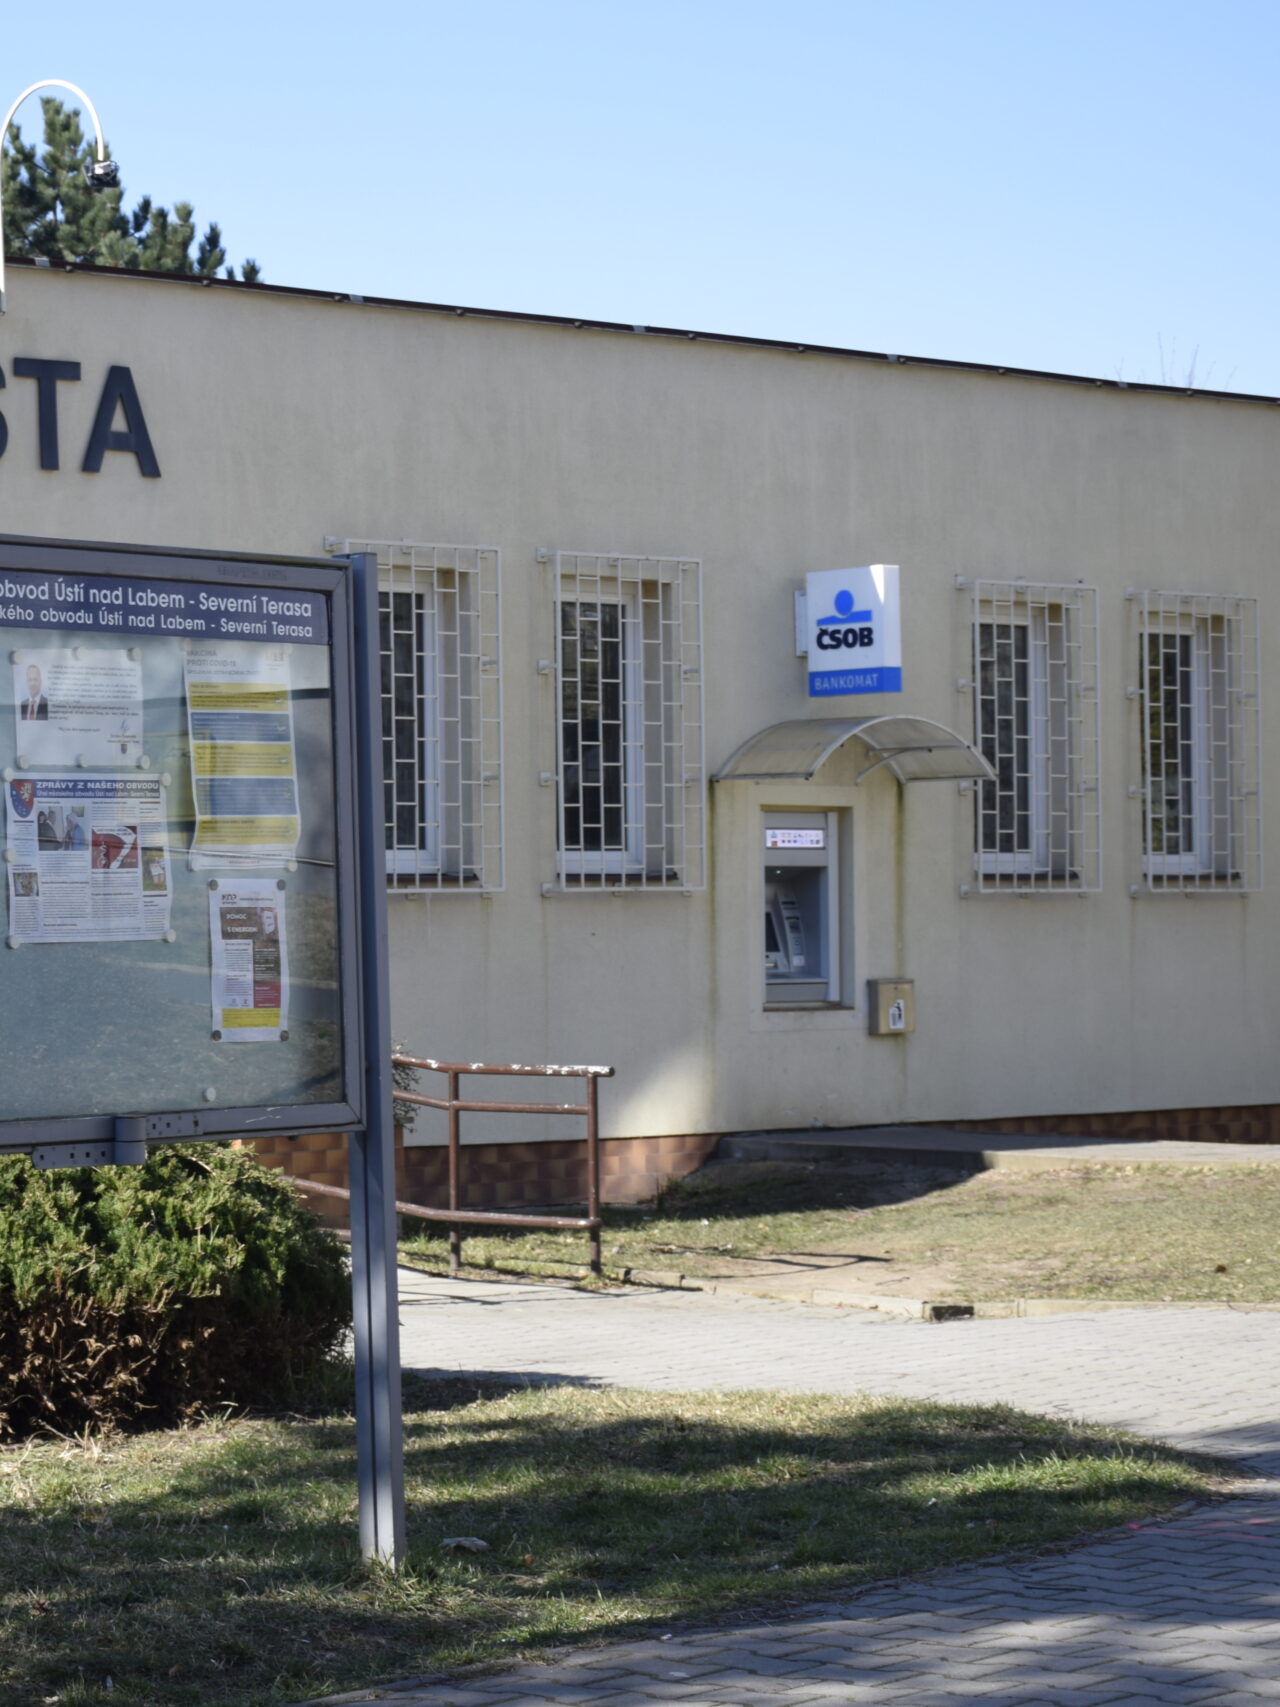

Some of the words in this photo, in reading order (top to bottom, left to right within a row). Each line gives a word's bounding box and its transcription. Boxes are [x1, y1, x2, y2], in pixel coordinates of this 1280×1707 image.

[55, 577, 84, 602] Ústí
[90, 587, 122, 604] nad
[128, 588, 184, 609] Labem
[200, 592, 257, 613] Severní
[261, 596, 312, 617] Terasa
[40, 608, 93, 624] obvodu
[99, 606, 123, 626] Ústí
[128, 614, 155, 628] nad
[161, 615, 206, 631] Labem
[220, 618, 267, 635] Severní
[272, 621, 312, 637] Terasa
[816, 627, 874, 651] ČSOB
[814, 673, 879, 691] BANKOMAT
[36, 780, 74, 789] ZPRÁVY
[77, 781, 84, 789] Z
[87, 781, 124, 789] NAŠEHO
[126, 782, 159, 790] OBVODU
